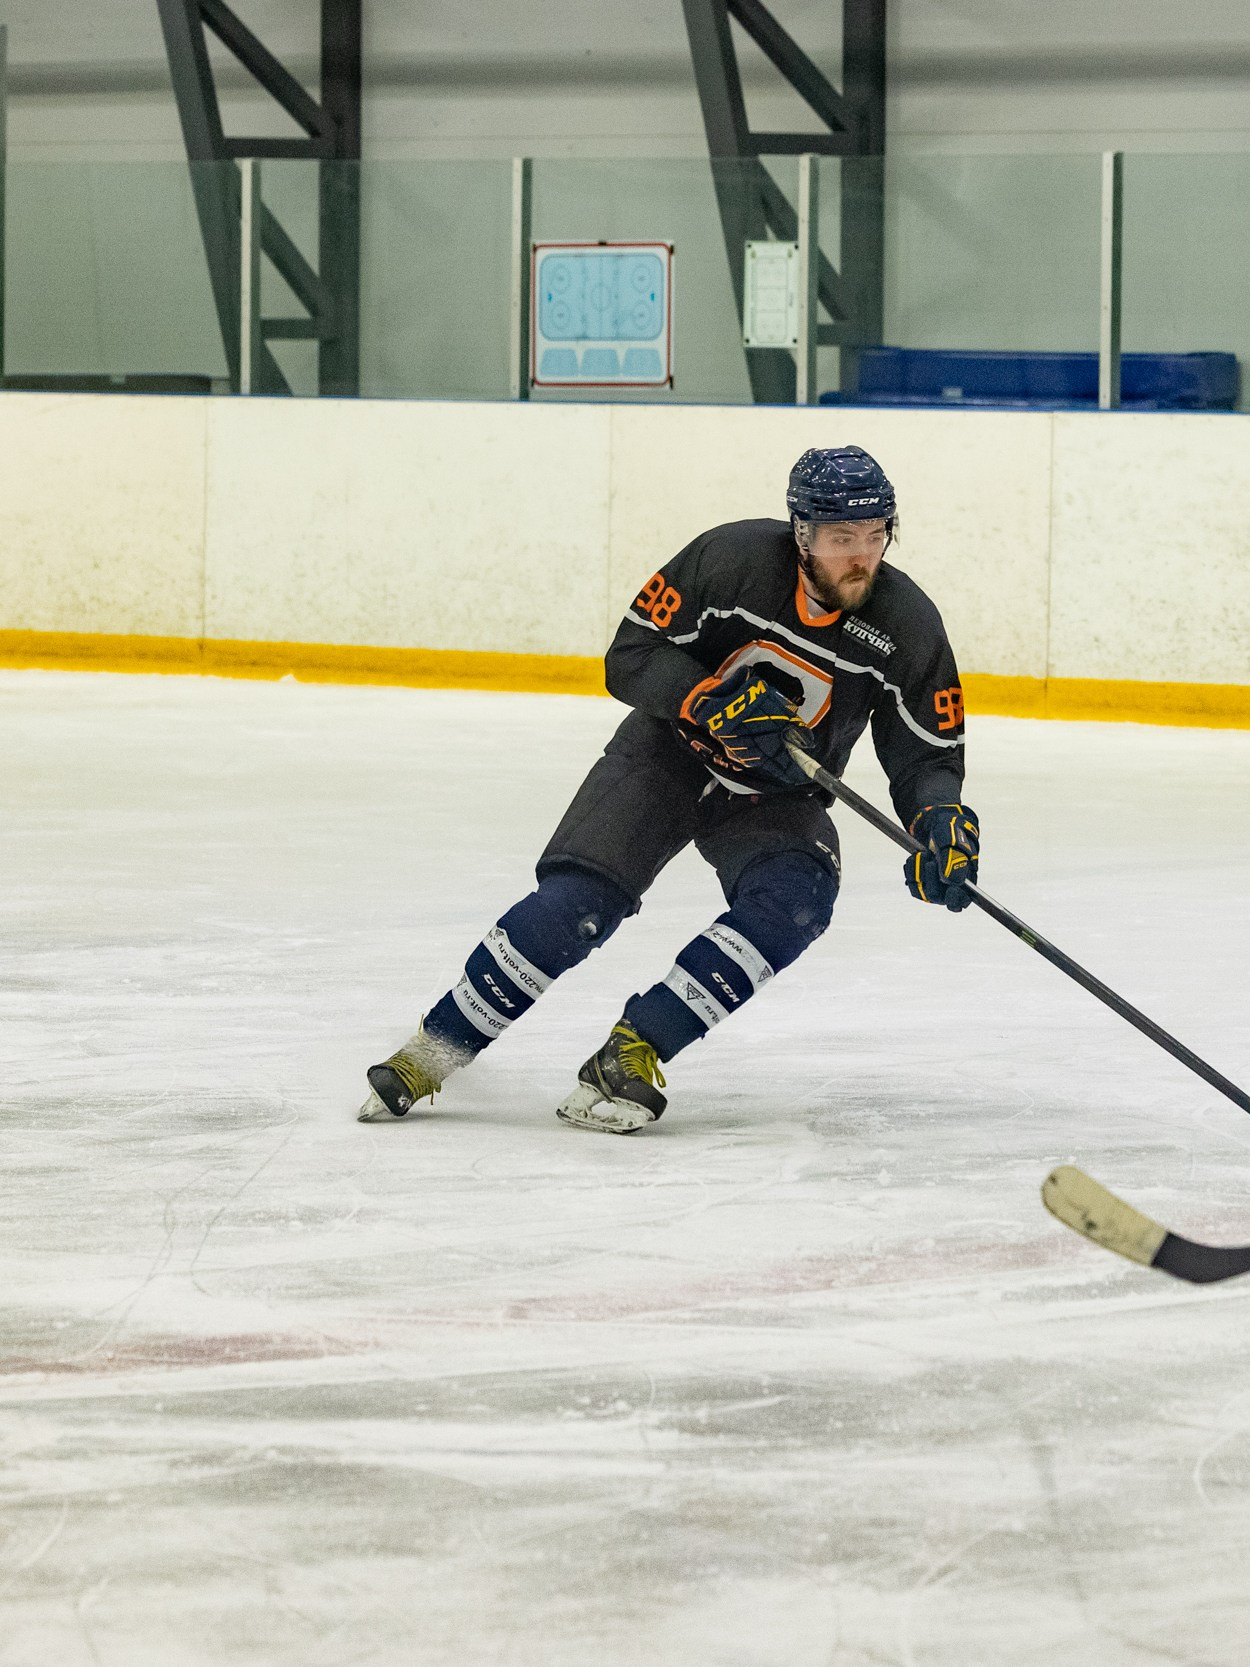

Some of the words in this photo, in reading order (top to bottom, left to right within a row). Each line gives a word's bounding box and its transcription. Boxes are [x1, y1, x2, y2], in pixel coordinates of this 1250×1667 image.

[847, 497, 880, 506] CCM
[636, 572, 681, 628] 98
[707, 680, 767, 731] CCM
[482, 973, 516, 1009] CCM
[711, 971, 740, 1003] CCM
